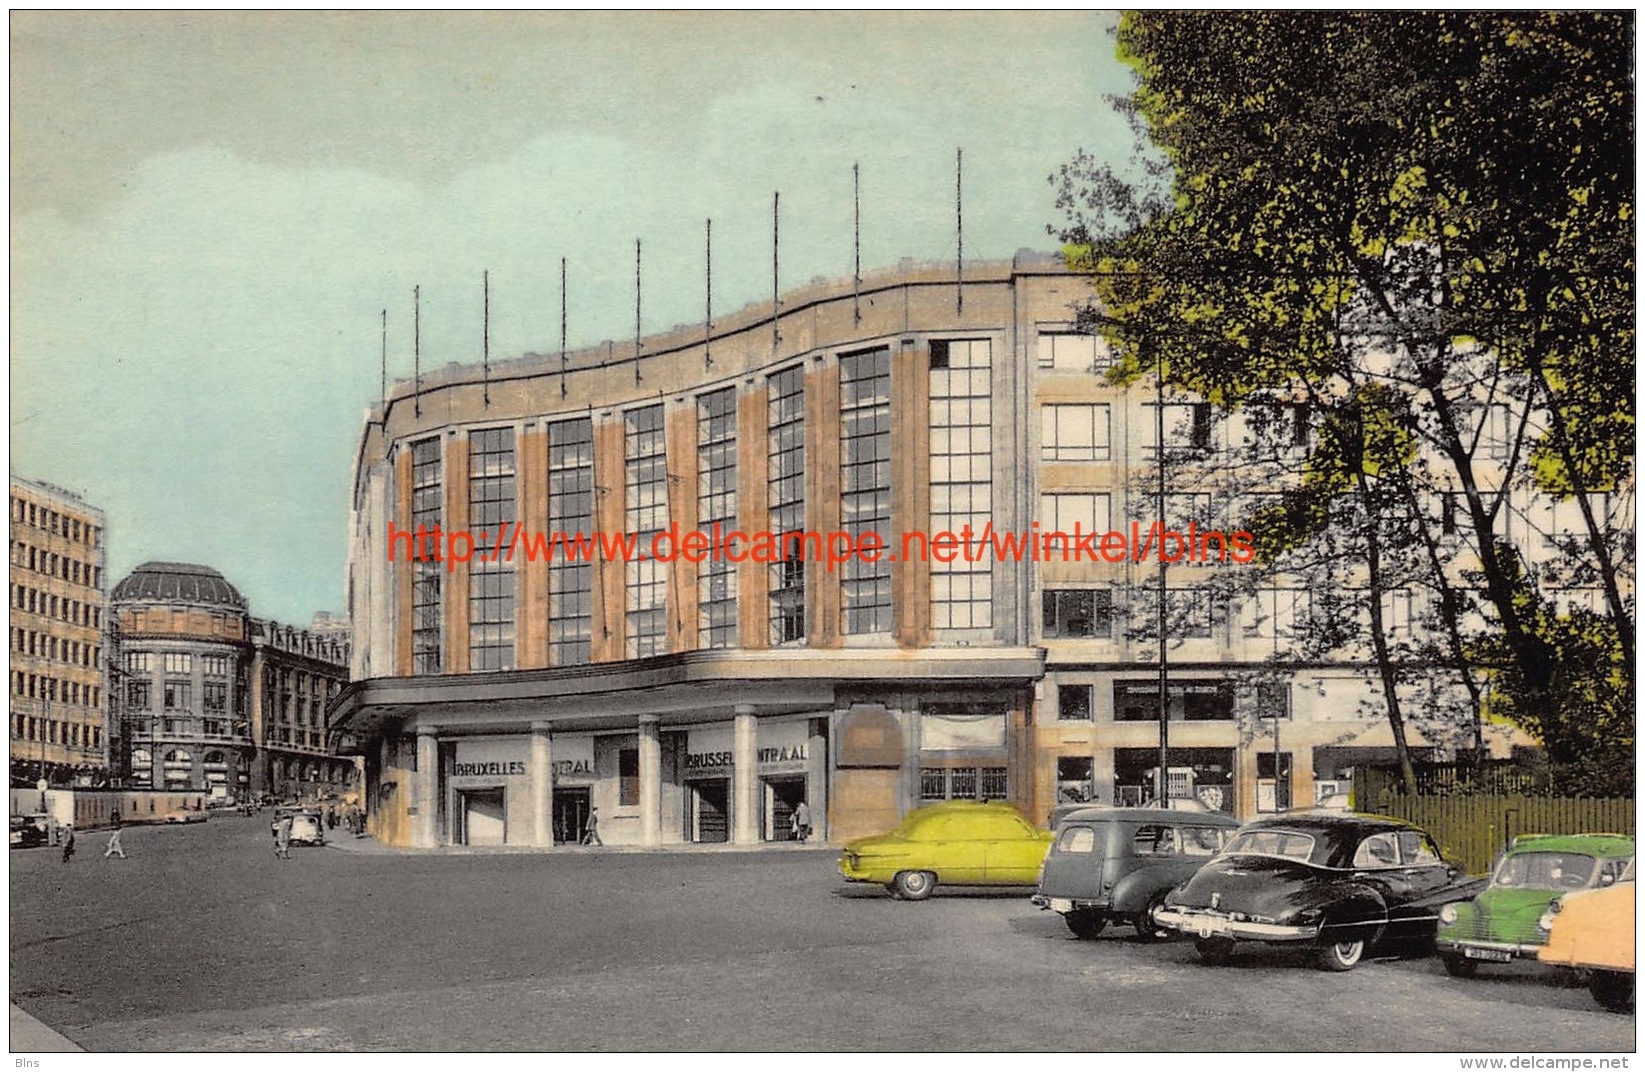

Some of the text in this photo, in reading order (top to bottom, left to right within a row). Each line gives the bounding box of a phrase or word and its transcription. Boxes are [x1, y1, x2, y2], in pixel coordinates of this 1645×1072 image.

[686, 745, 808, 768] BRUSSEL NTRAAL
[455, 761, 525, 776] BRUXELLES
